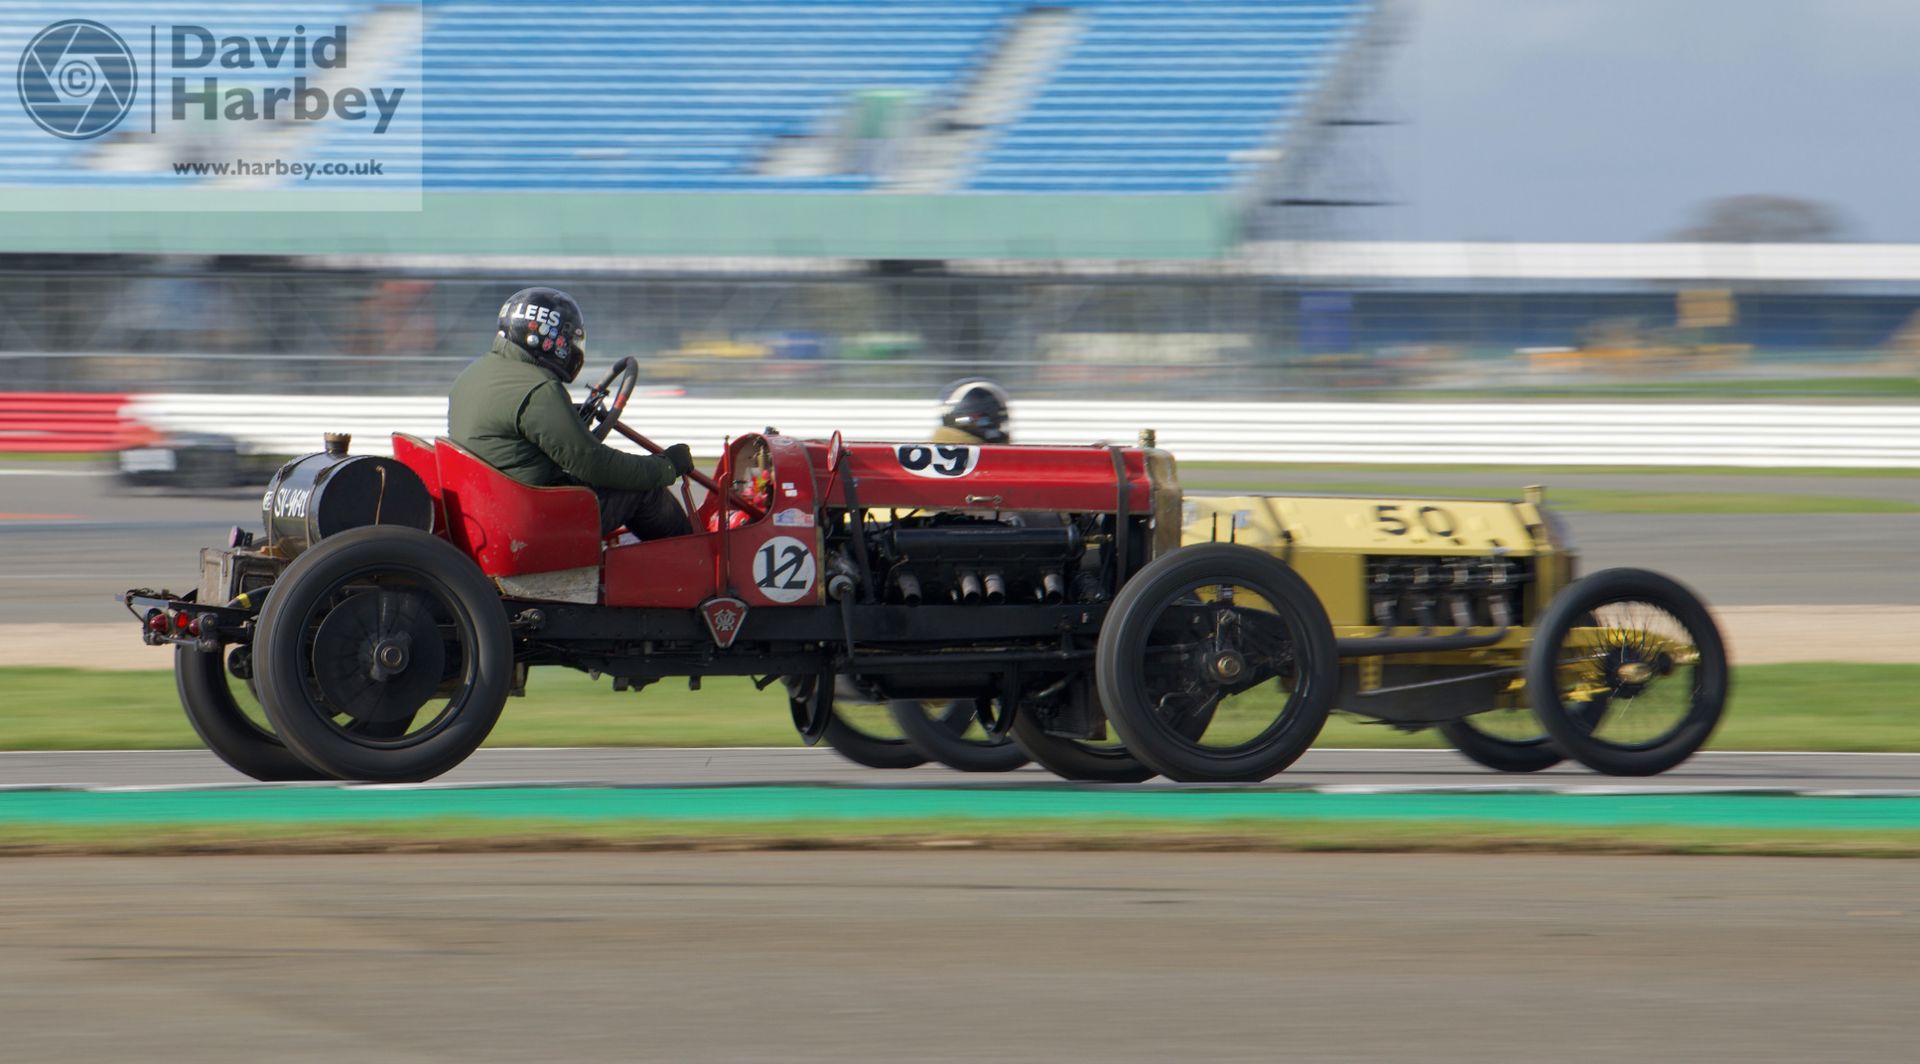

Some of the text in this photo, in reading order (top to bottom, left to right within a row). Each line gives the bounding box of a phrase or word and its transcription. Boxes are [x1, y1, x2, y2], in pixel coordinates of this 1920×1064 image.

[511, 303, 560, 327] LEES
[1373, 505, 1458, 537] 50
[757, 545, 808, 589] 12
